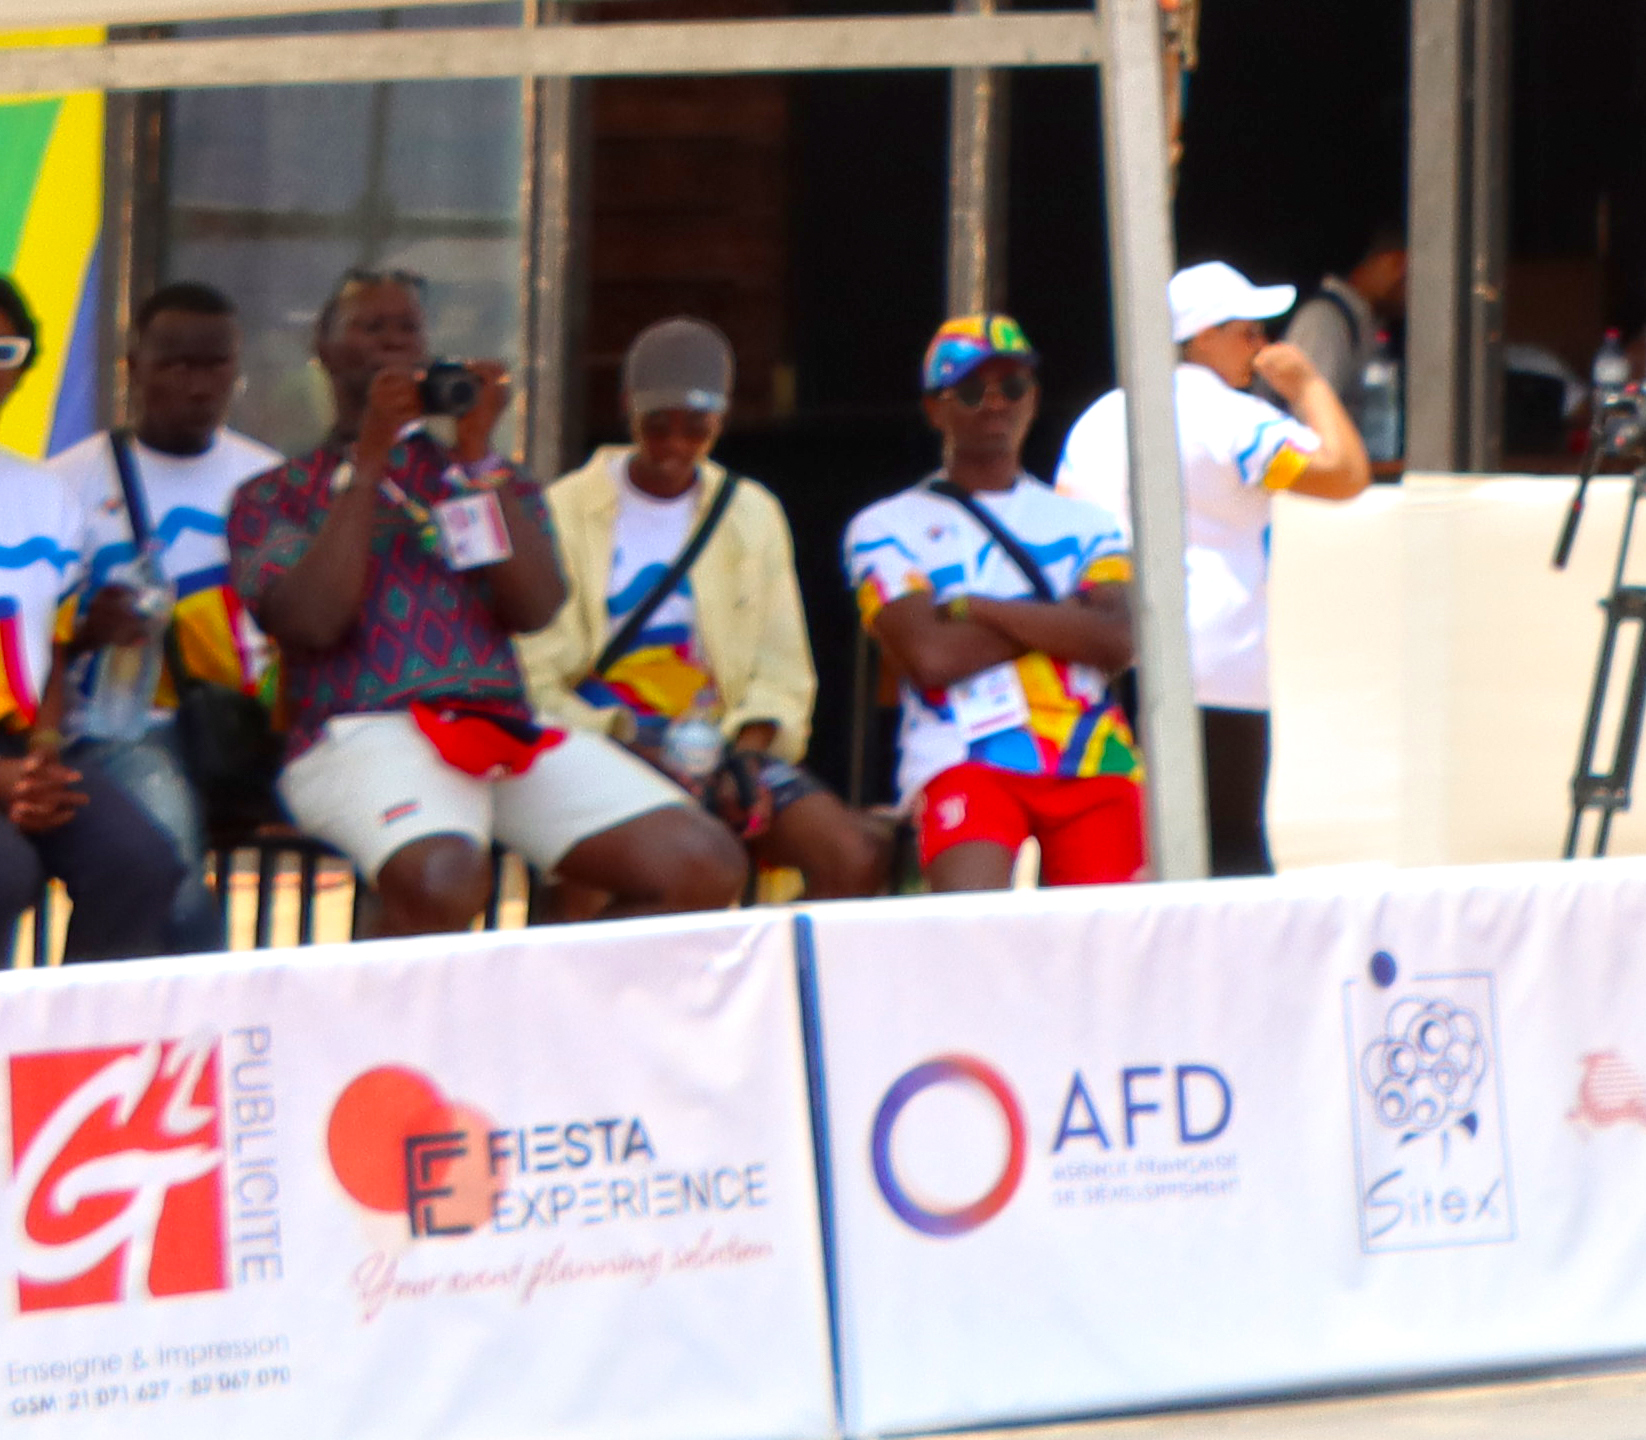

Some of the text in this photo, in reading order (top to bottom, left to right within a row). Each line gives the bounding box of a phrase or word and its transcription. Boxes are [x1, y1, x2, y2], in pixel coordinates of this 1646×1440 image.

[1052, 1063, 1234, 1154] AFD
[487, 1117, 657, 1176] FIESTA
[491, 1162, 770, 1234] EXPERIENCE
[7, 1334, 291, 1386] Enseigne & Impression
